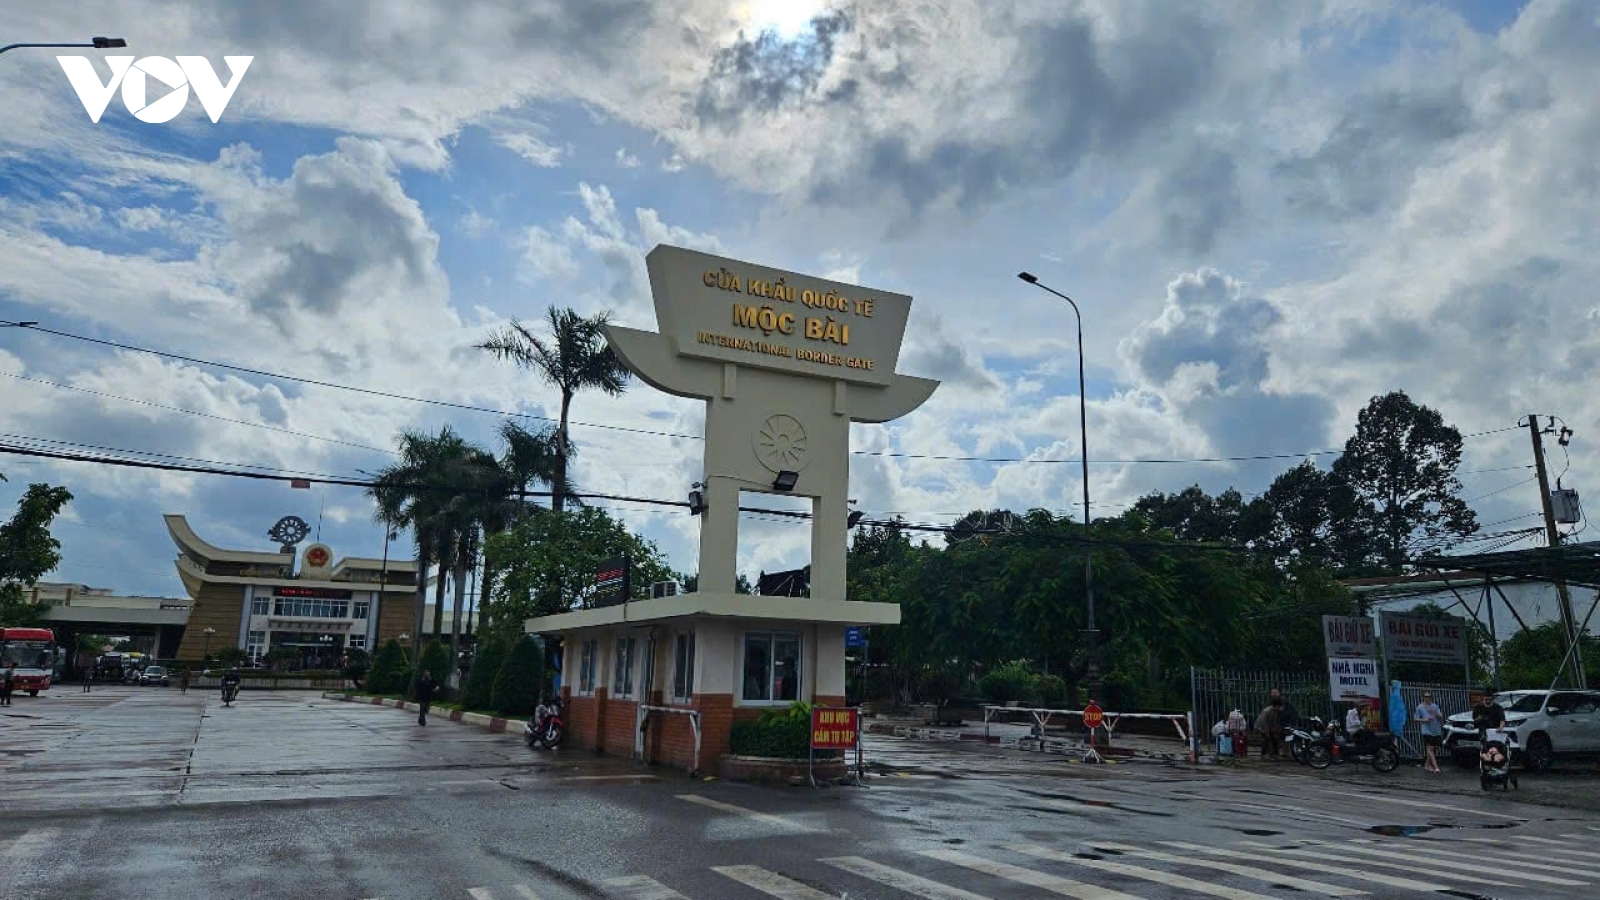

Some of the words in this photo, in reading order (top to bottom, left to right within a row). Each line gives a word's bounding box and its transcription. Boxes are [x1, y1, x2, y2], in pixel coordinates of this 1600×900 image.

[704, 268, 741, 292] CỬA
[748, 278, 798, 303] KHẨU
[801, 289, 849, 312] QUỐC
[853, 297, 876, 317] TẾ
[733, 303, 795, 336] MỘC
[805, 316, 850, 345] BÀI
[699, 332, 791, 357] INTERNATIONAL
[796, 349, 842, 367] BORDER
[846, 358, 875, 371] GATE
[1442, 626, 1461, 639] XE
[1331, 660, 1350, 674] NHÀ
[1339, 676, 1369, 686] MOTEL
[820, 711, 834, 724] KHU
[835, 711, 849, 726] VỰC
[1085, 706, 1102, 720] STOP
